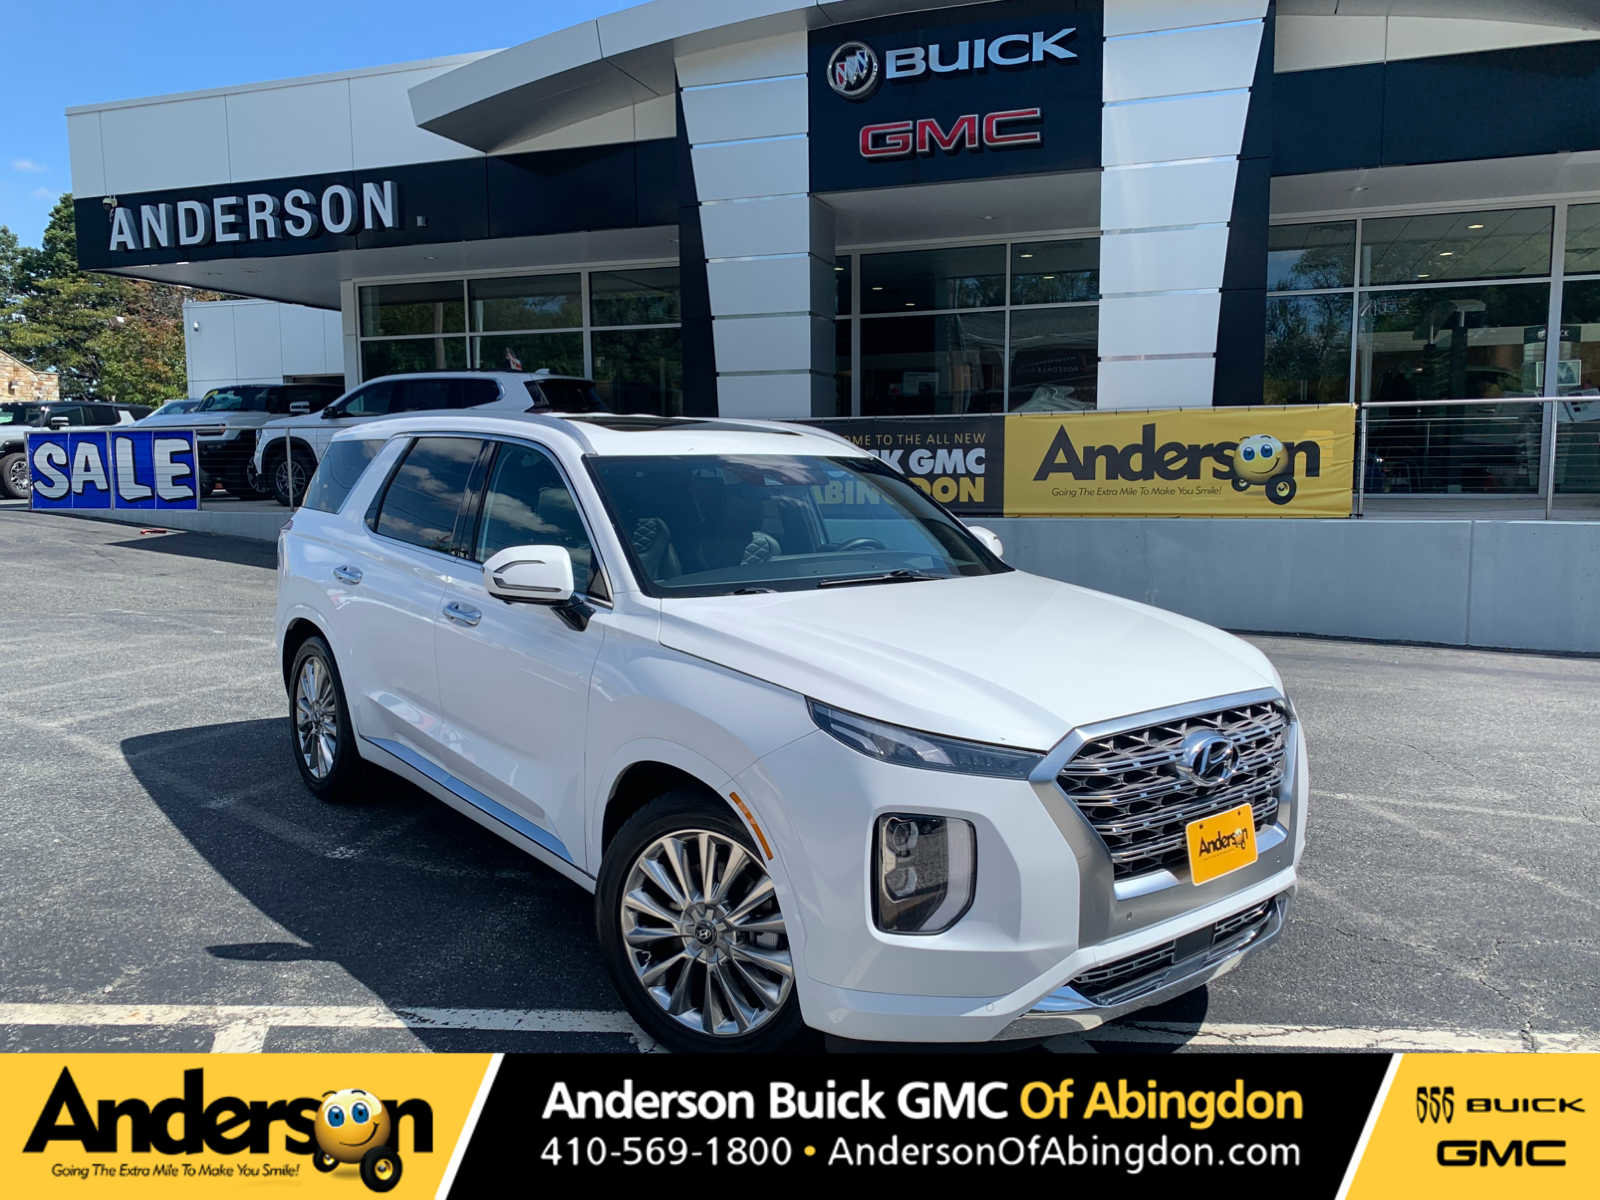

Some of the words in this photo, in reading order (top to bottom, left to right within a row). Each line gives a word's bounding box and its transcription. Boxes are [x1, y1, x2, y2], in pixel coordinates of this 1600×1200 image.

[885, 27, 1079, 79] BUICK
[859, 107, 1041, 158] GMC
[109, 180, 398, 251] ANDERSON
[876, 434, 893, 446] TO
[897, 433, 921, 445] THE
[926, 433, 950, 444] ALL
[954, 432, 986, 444] NEW
[908, 447, 986, 475] GMC
[32, 436, 195, 502] SALE
[1051, 487, 1077, 498] Going
[1079, 487, 1095, 496] The
[1096, 487, 1118, 496] Extra
[1119, 487, 1138, 496] Mile
[1140, 487, 1150, 496] To
[1151, 487, 1176, 496] Make
[1178, 486, 1194, 495] You
